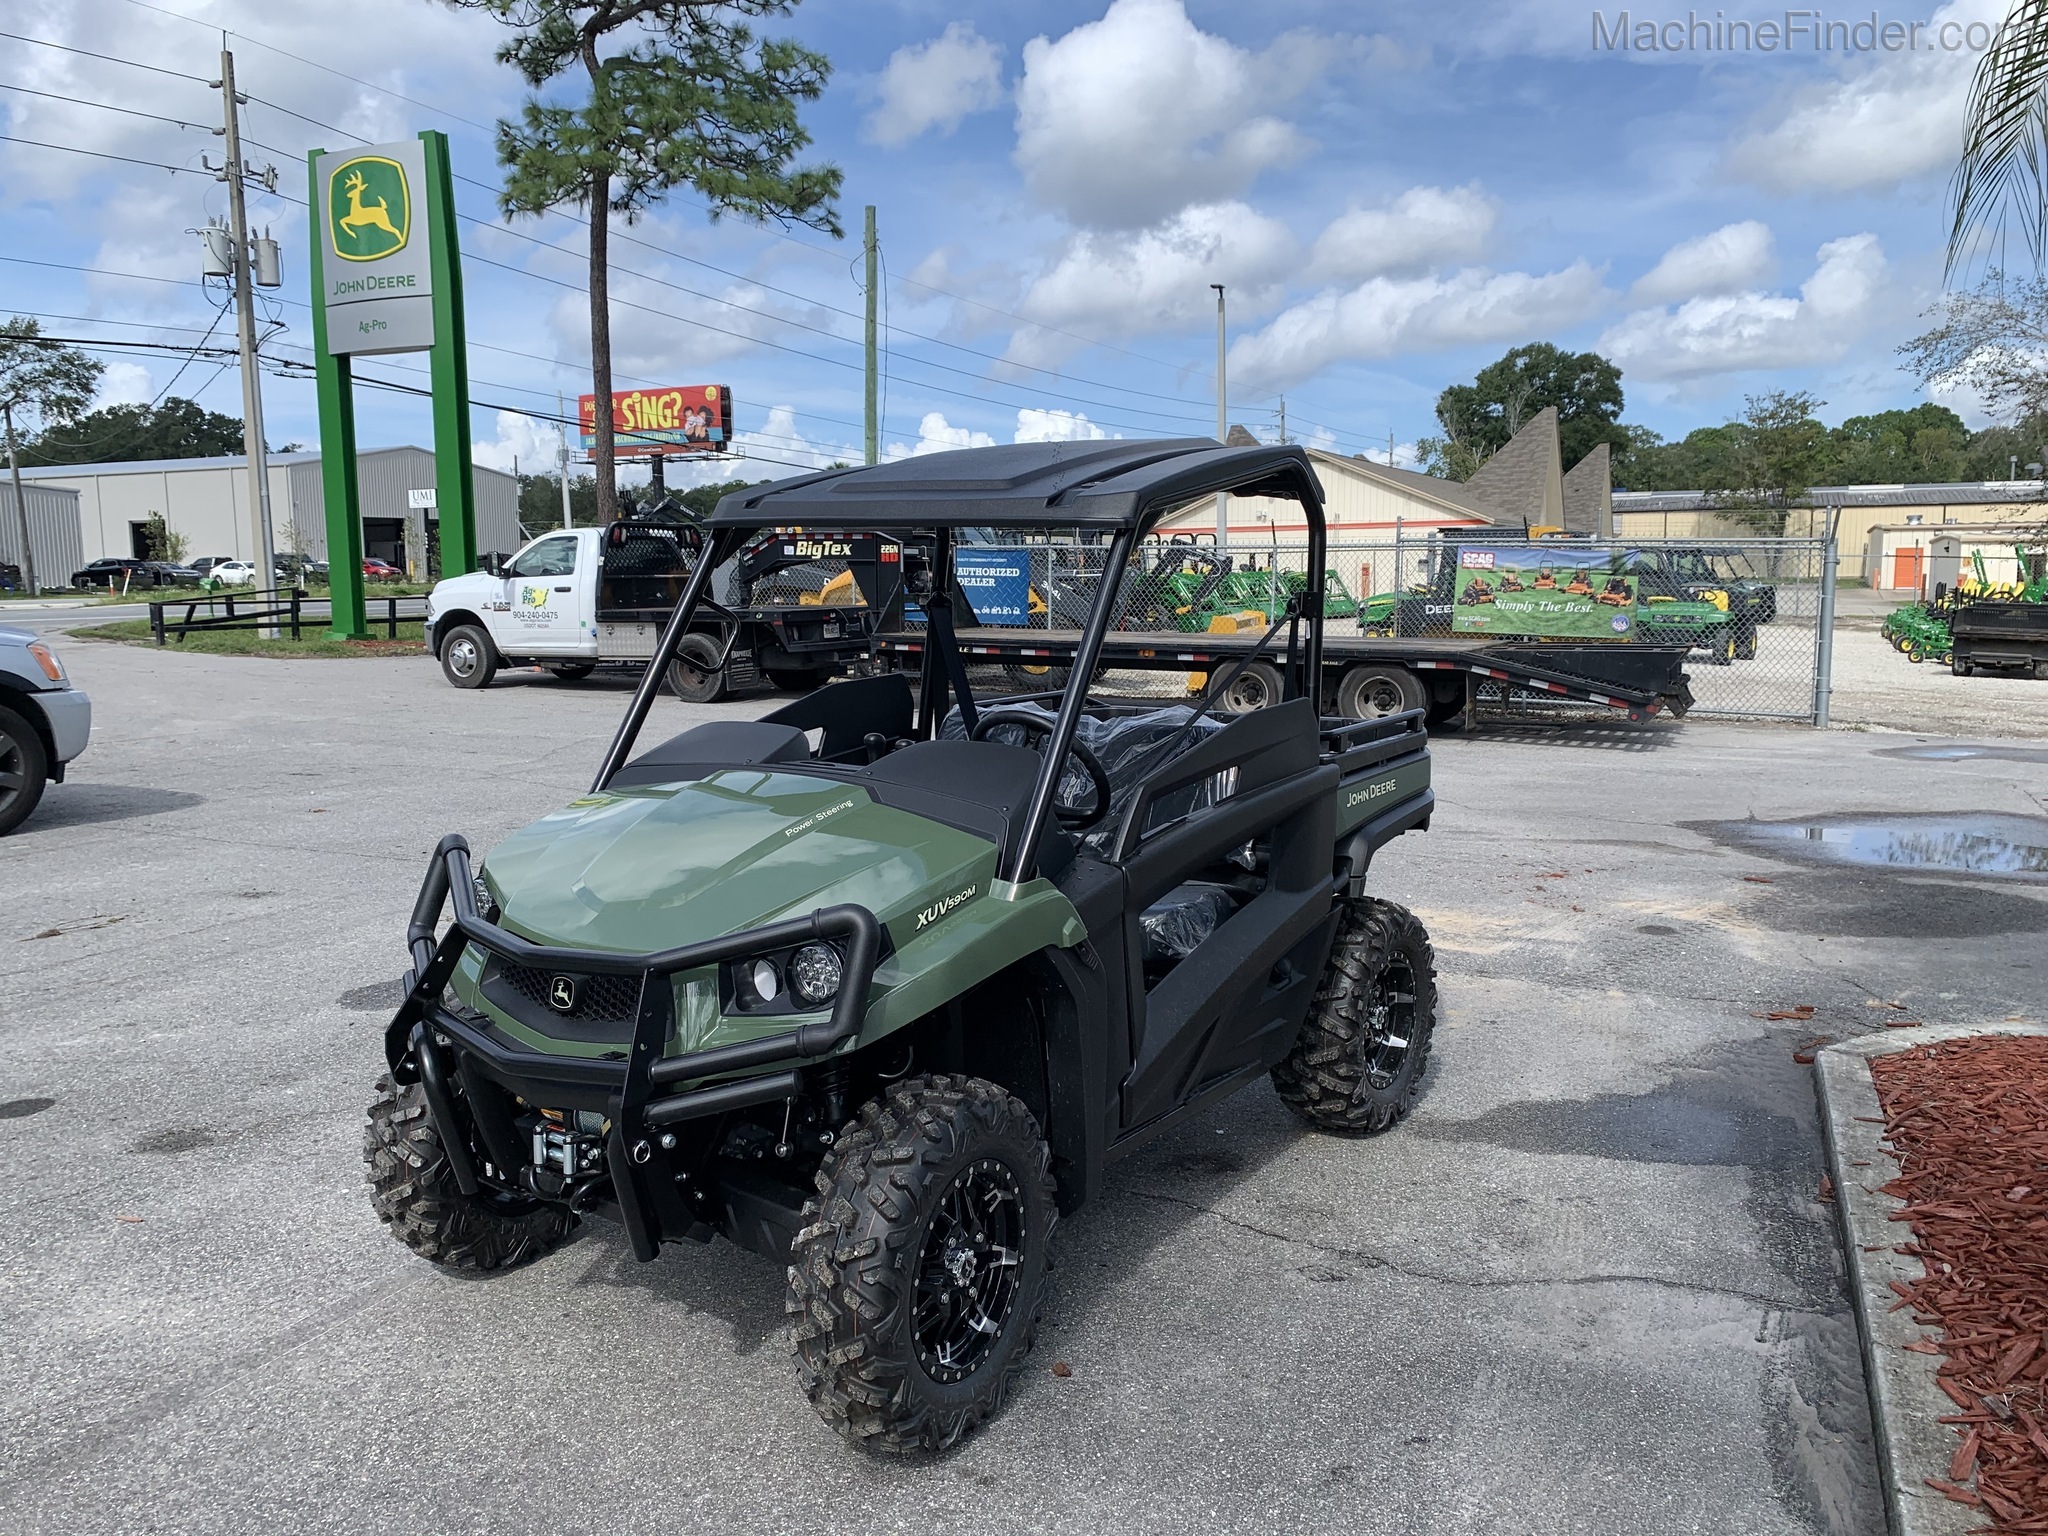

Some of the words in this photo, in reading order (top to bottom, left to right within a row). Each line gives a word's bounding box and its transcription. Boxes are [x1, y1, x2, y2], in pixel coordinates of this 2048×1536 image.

[333, 278, 366, 296] JOHN
[367, 274, 416, 291] DEERE
[358, 318, 387, 333] Ag-Pro
[412, 490, 433, 502] UMI
[795, 540, 853, 559] BigTex
[880, 553, 899, 563] HD
[1462, 552, 1494, 564] SCAG
[957, 567, 1020, 577] AUTHORIZED
[957, 577, 996, 587] DEALER
[522, 595, 536, 604] Pro
[1425, 604, 1454, 615] DEE
[1493, 599, 1535, 613] Simply
[1538, 601, 1562, 612] The
[1565, 602, 1594, 613] Best.
[512, 611, 559, 619] 904-240-0475
[1346, 788, 1369, 808] JOHN
[1370, 778, 1397, 799] DEERE
[785, 817, 815, 838] Power
[815, 799, 854, 822] Steering
[914, 884, 977, 932] XUV590M
